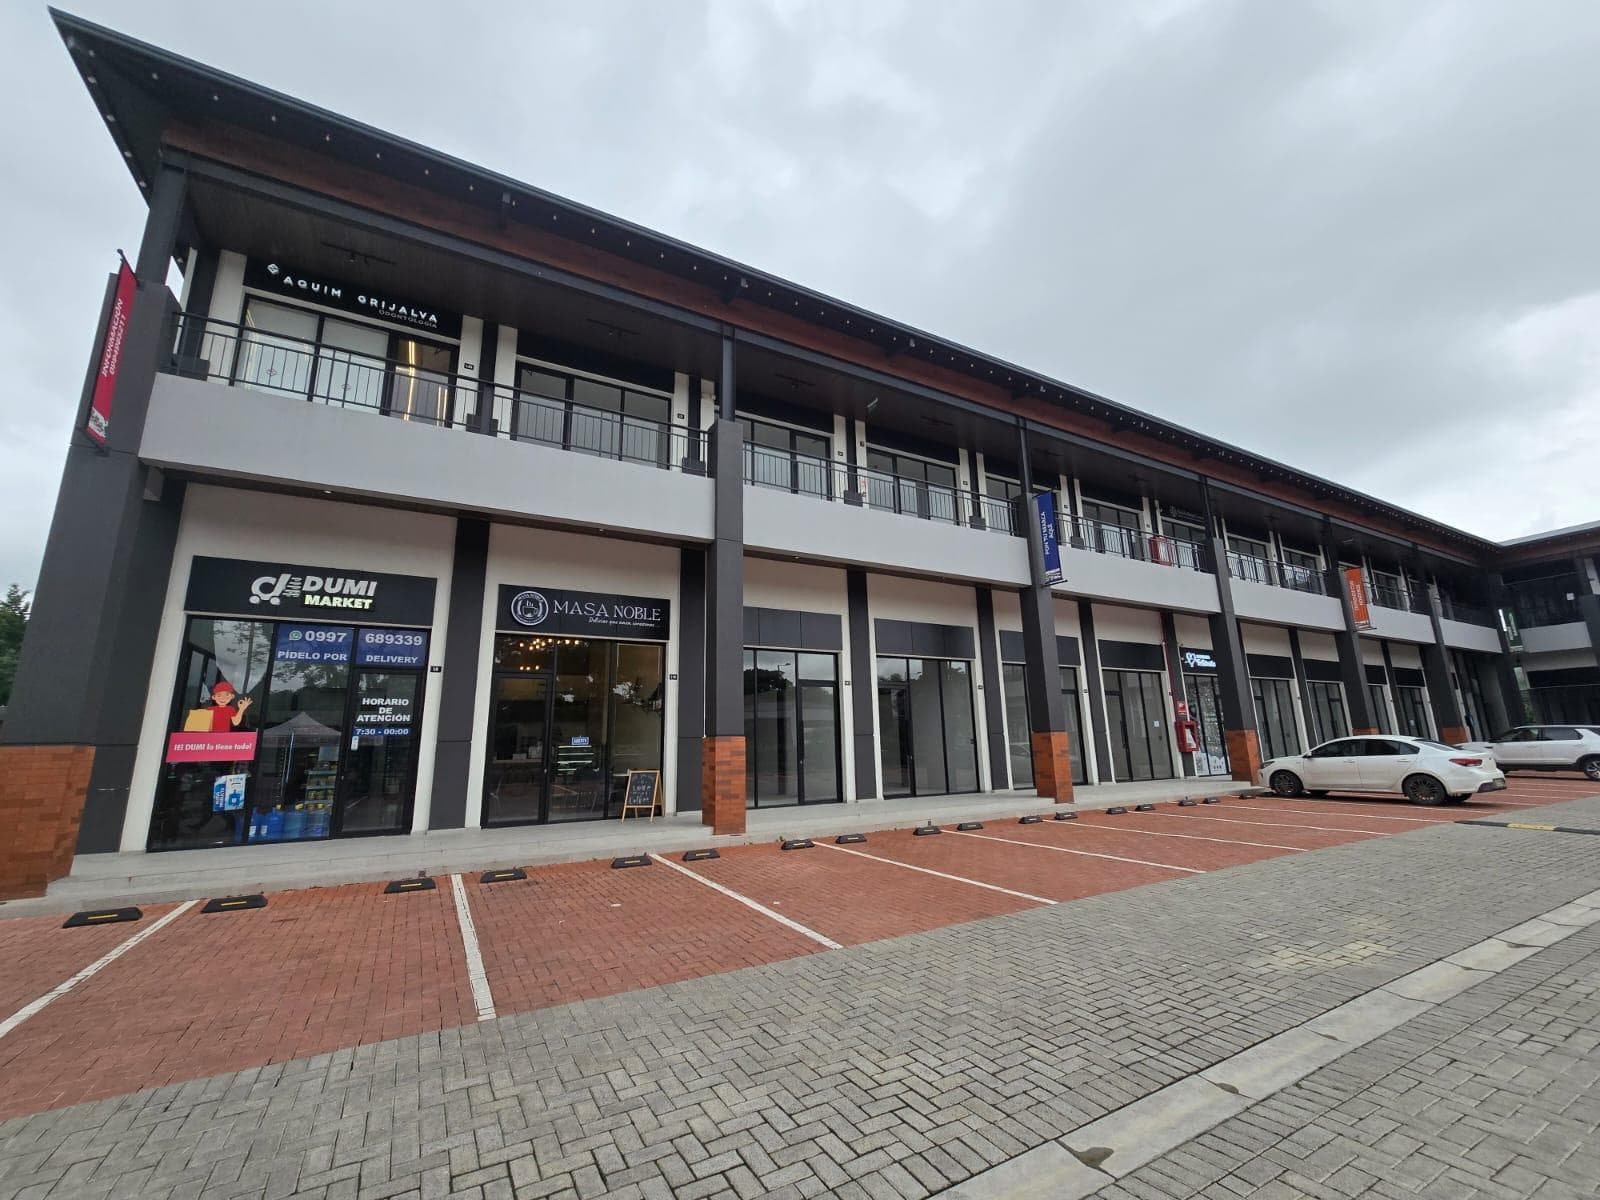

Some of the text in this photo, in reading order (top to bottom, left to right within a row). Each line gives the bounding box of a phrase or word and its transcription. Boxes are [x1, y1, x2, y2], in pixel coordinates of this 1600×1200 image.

[283, 275, 438, 323] AQUIM GRIJALVA
[102, 298, 124, 377] INFORMACIÓN
[302, 575, 378, 597] DUMI
[304, 594, 373, 609] MARKET
[553, 599, 609, 618] MASA
[613, 605, 661, 621] NOBLE
[304, 630, 423, 646] 0997 689339
[277, 650, 419, 664] PÍDELO POR DELIVERY
[361, 697, 410, 706] HORARIO
[378, 706, 393, 714] DE
[356, 713, 411, 722] ATENCIÓN
[355, 728, 376, 736] 7:30
[383, 728, 409, 736] 00:00
[185, 743, 206, 751] DUMI
[206, 742, 214, 750] lo
[234, 742, 252, 750] todo!
